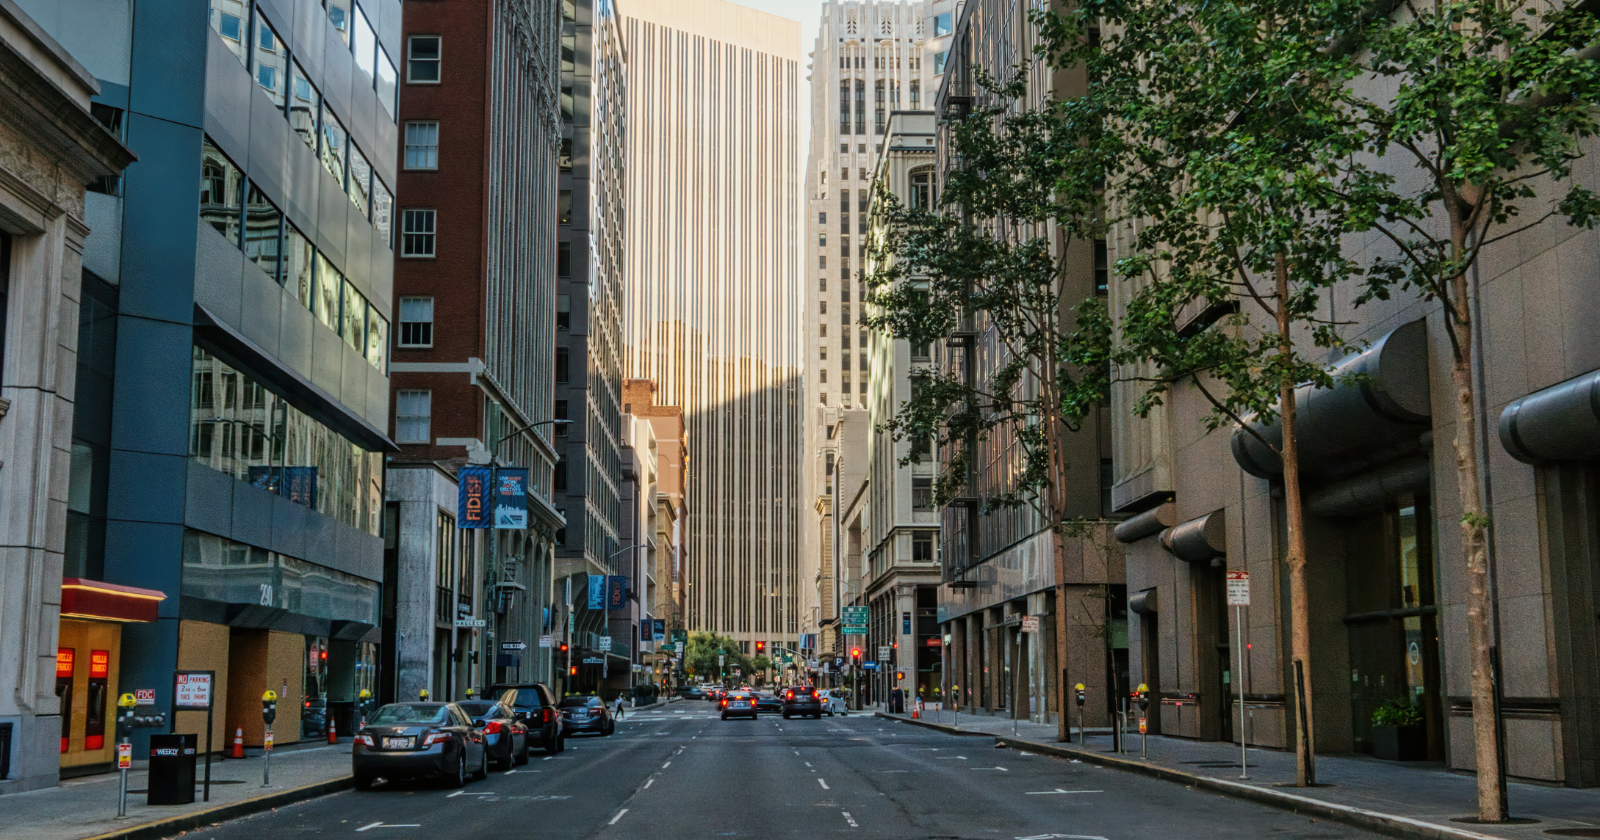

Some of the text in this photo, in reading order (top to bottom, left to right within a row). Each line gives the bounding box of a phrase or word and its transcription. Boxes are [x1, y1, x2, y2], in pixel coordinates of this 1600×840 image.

[93, 655, 107, 663] WELLS
[92, 664, 107, 672] FARGO
[178, 675, 187, 684] NO
[138, 690, 153, 699] FDC
